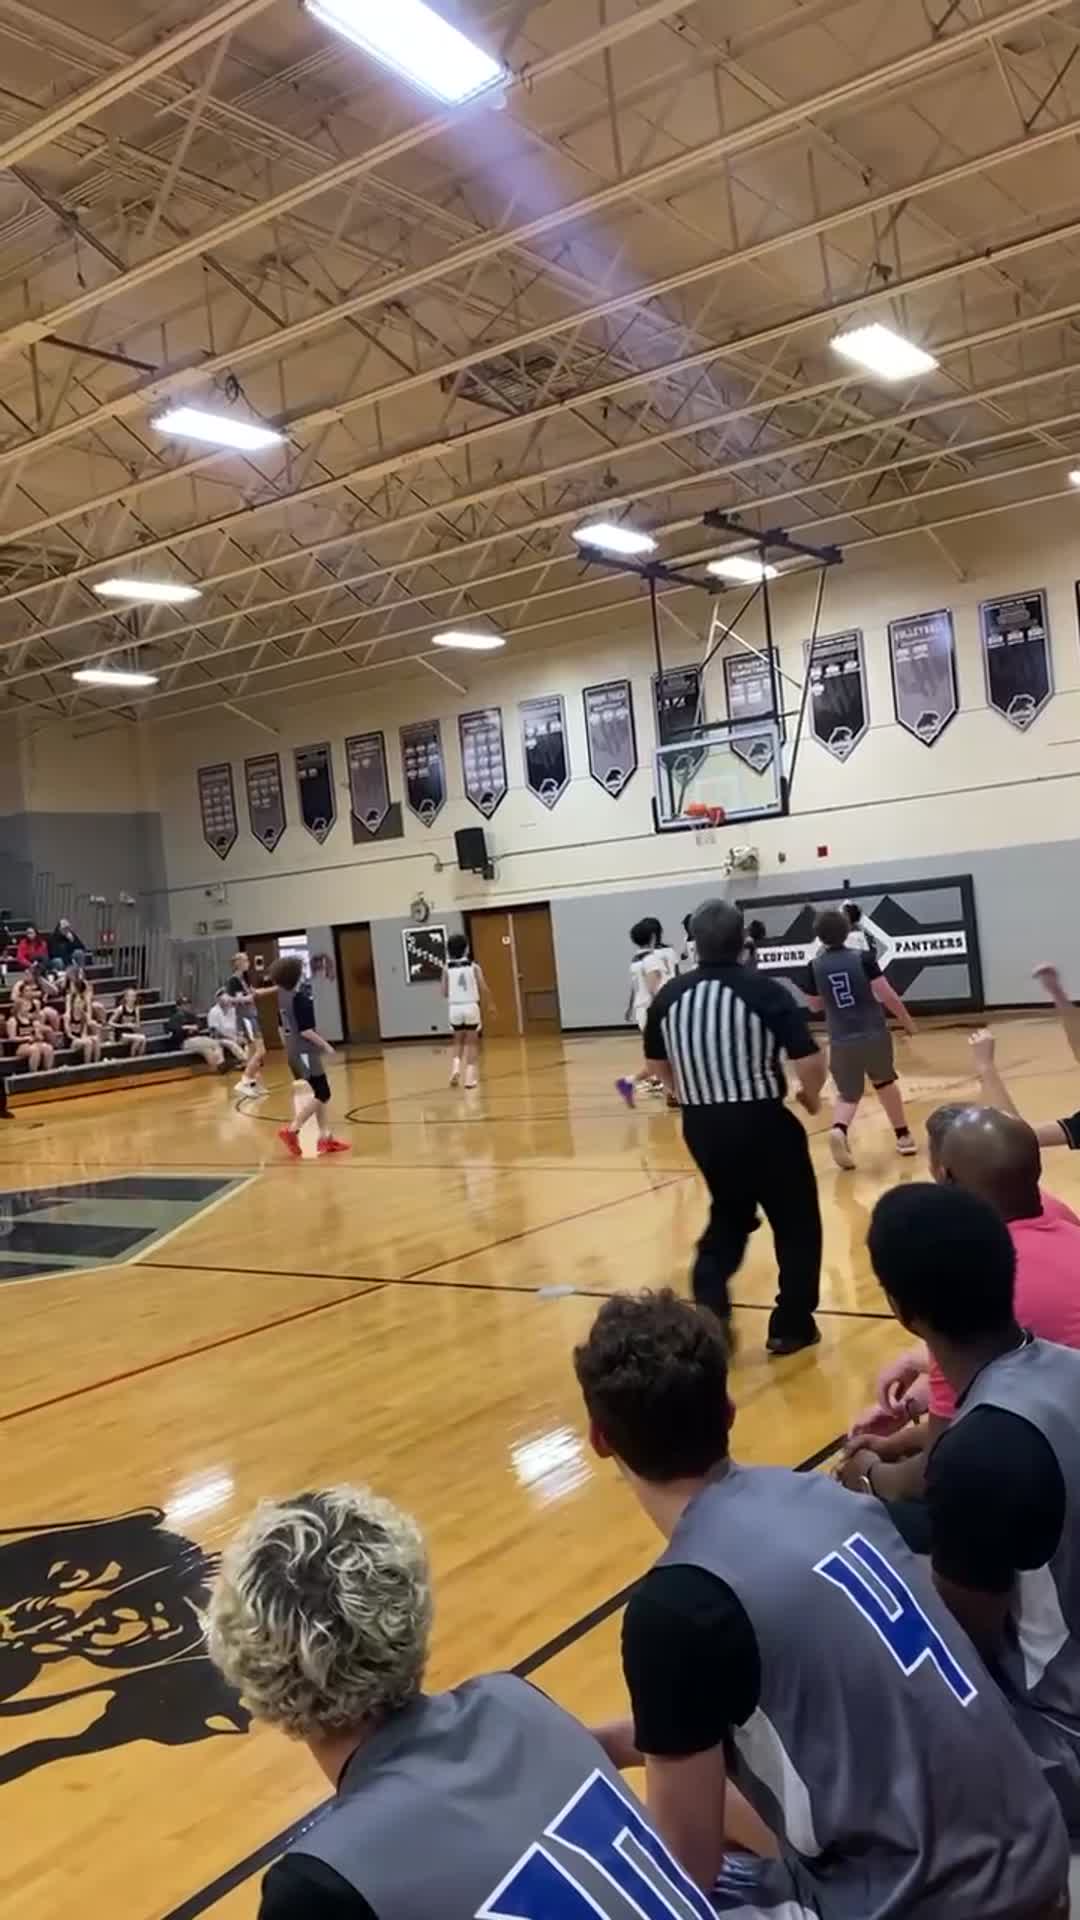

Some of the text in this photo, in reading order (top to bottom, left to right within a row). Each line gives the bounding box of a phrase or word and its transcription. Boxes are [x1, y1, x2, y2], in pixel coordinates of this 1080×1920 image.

[895, 937, 963, 952] PANTHERS
[457, 972, 468, 992] 4
[828, 971, 856, 1009] 2
[813, 1531, 978, 1707] 4
